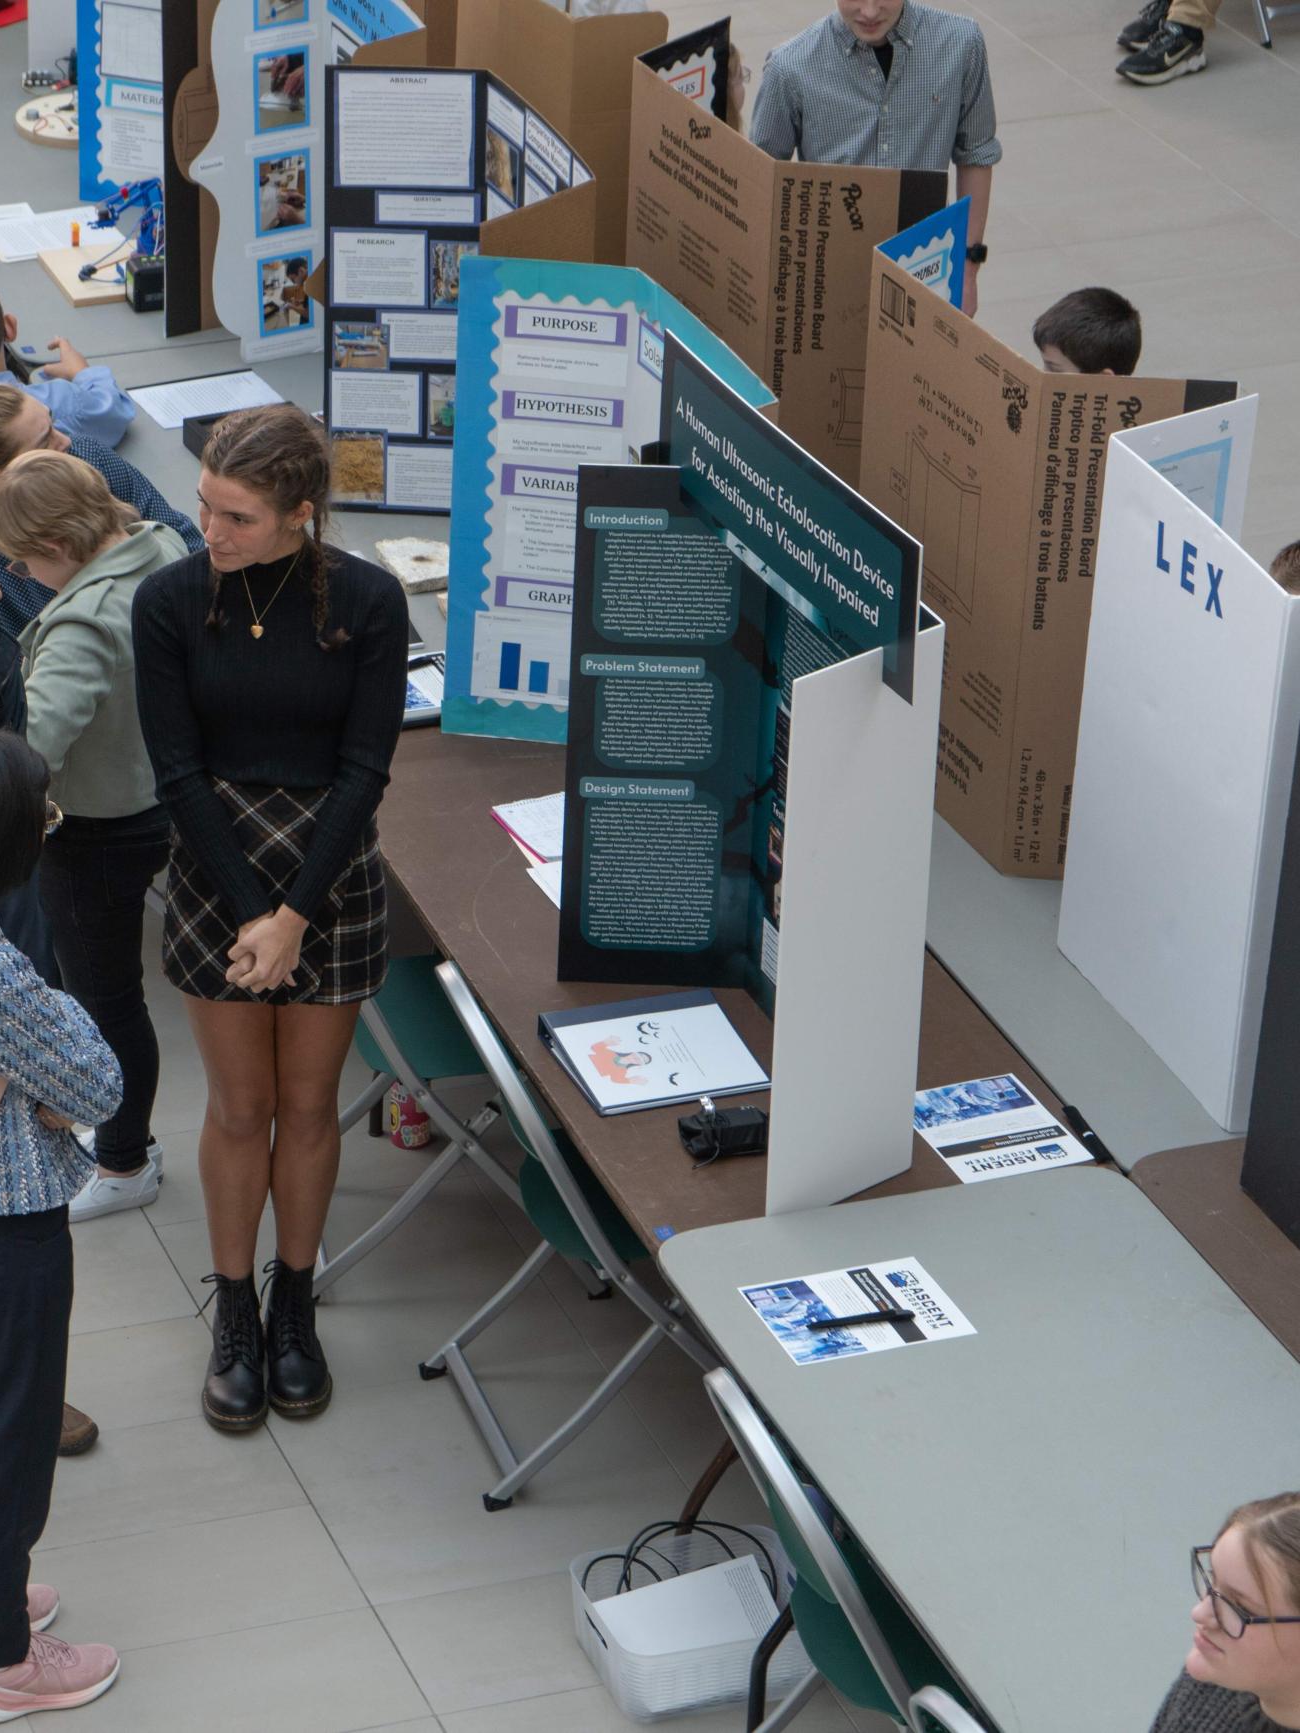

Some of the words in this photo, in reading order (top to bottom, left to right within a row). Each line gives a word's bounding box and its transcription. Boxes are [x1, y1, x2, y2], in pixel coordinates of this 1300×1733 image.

[350, 7, 368, 38] Way
[120, 91, 163, 105] MATERIA
[688, 118, 711, 140] Pacon
[661, 124, 682, 149] Tri-Fold
[683, 139, 719, 176] Presentation
[720, 167, 738, 190] Board
[649, 149, 672, 178] Panneau
[724, 205, 748, 233] battants
[781, 178, 795, 232] Panneau
[818, 180, 832, 227] Tri-Fold
[840, 183, 864, 231] Pacon
[794, 229, 808, 258] para
[774, 235, 792, 300] d'affichage
[812, 230, 829, 309] Presentation
[792, 261, 807, 354] presentaciones
[532, 316, 598, 333] PURPOSE
[774, 313, 787, 345] trois
[811, 312, 825, 350] Board
[772, 348, 787, 398] battants
[516, 398, 608, 418] HYPOTHESIS
[1048, 391, 1066, 450] Panneau
[1090, 394, 1108, 445] Tri-Fold
[1117, 396, 1142, 429] Pac
[1064, 447, 1079, 478] para
[676, 396, 684, 418] A
[685, 402, 720, 452] Human
[722, 437, 775, 501] Ultrasonic
[777, 486, 850, 565] Echolocation
[853, 549, 894, 600] Device
[1038, 454, 1062, 526] d'affichage
[1084, 448, 1103, 533] Presentation
[589, 513, 663, 525] Introduction
[1057, 482, 1077, 583] presentaciones
[692, 446, 706, 475] for
[707, 464, 753, 525] Assisting
[755, 509, 773, 538] the
[775, 522, 821, 583] Visually
[824, 563, 879, 627] Impaired
[1038, 541, 1052, 573] trois
[1078, 537, 1095, 578] Board
[1156, 520, 1223, 619] LEX
[528, 590, 573, 605] GRAPH
[1032, 576, 1051, 631] battants
[585, 660, 635, 672] Problem
[638, 662, 700, 674] Statement
[1020, 764, 1028, 774] m
[1021, 748, 1032, 761] 1.2
[585, 782, 625, 796] Design
[629, 784, 690, 796] Statement
[1036, 769, 1046, 782] 48
[1017, 806, 1025, 822] cm
[1032, 817, 1042, 827] in
[1033, 804, 1044, 816] 36
[1029, 840, 1040, 850] 12
[965, 1150, 1032, 1166] ECOSYSTEM
[972, 1154, 1036, 1173] ASCENT
[900, 1289, 939, 1330] ECOSYSTEM
[909, 1287, 954, 1329] ASCENT
